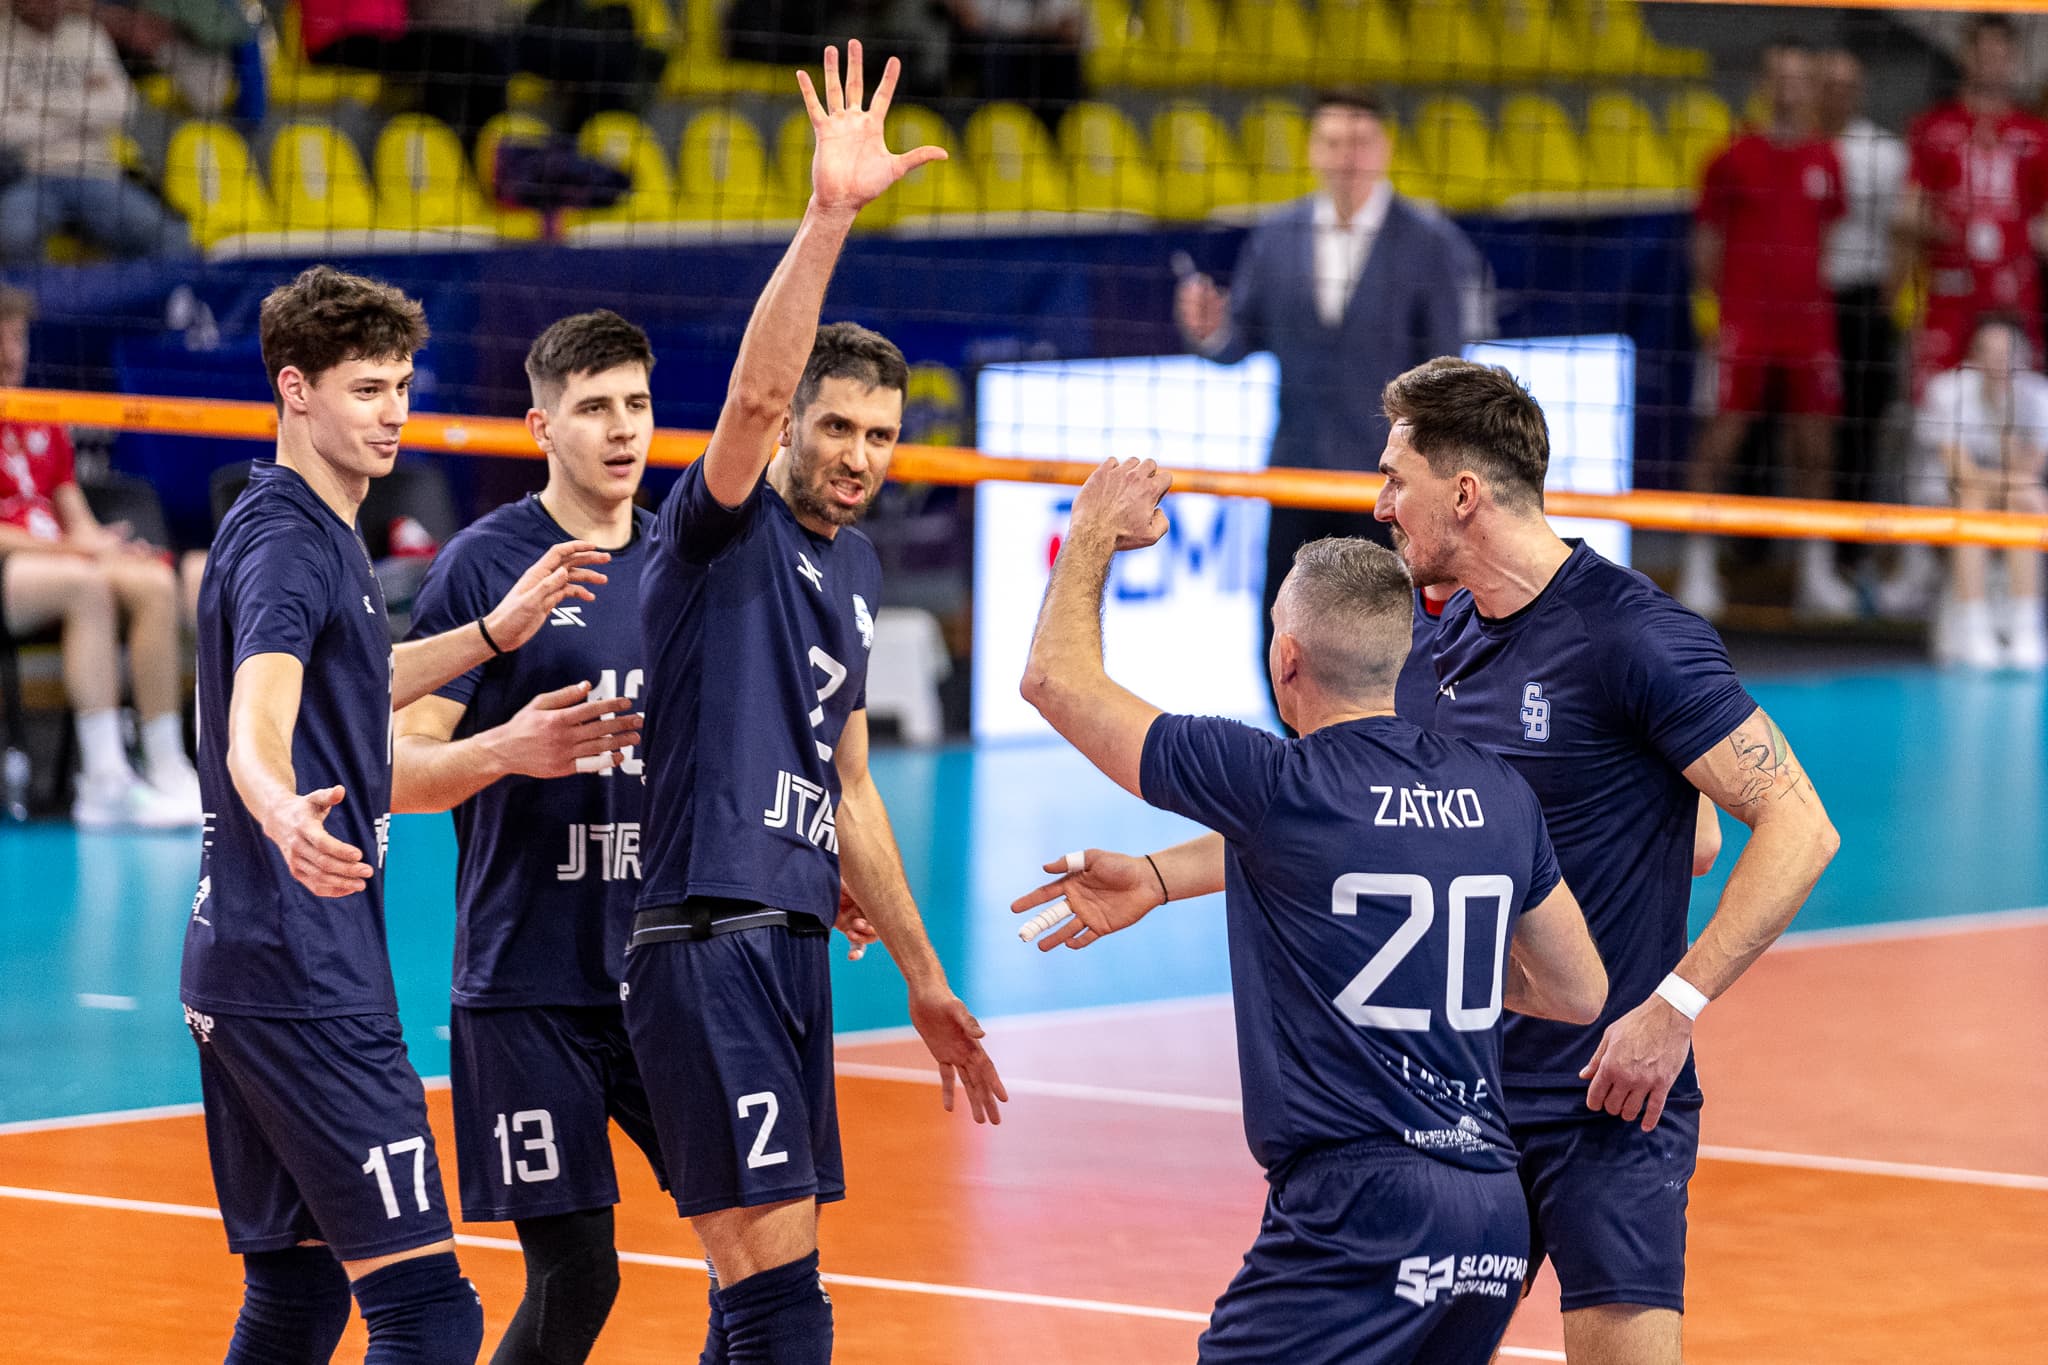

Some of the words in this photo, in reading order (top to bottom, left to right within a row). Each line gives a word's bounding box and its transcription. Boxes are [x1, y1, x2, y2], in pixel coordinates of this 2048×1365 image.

[1370, 781, 1485, 828] ZAŤKO
[1331, 872, 1515, 1032] 20
[494, 1108, 560, 1186] 13
[736, 1091, 788, 1169] 2
[361, 1135, 431, 1220] 17
[1451, 1280, 1508, 1299] SLOVAKIA
